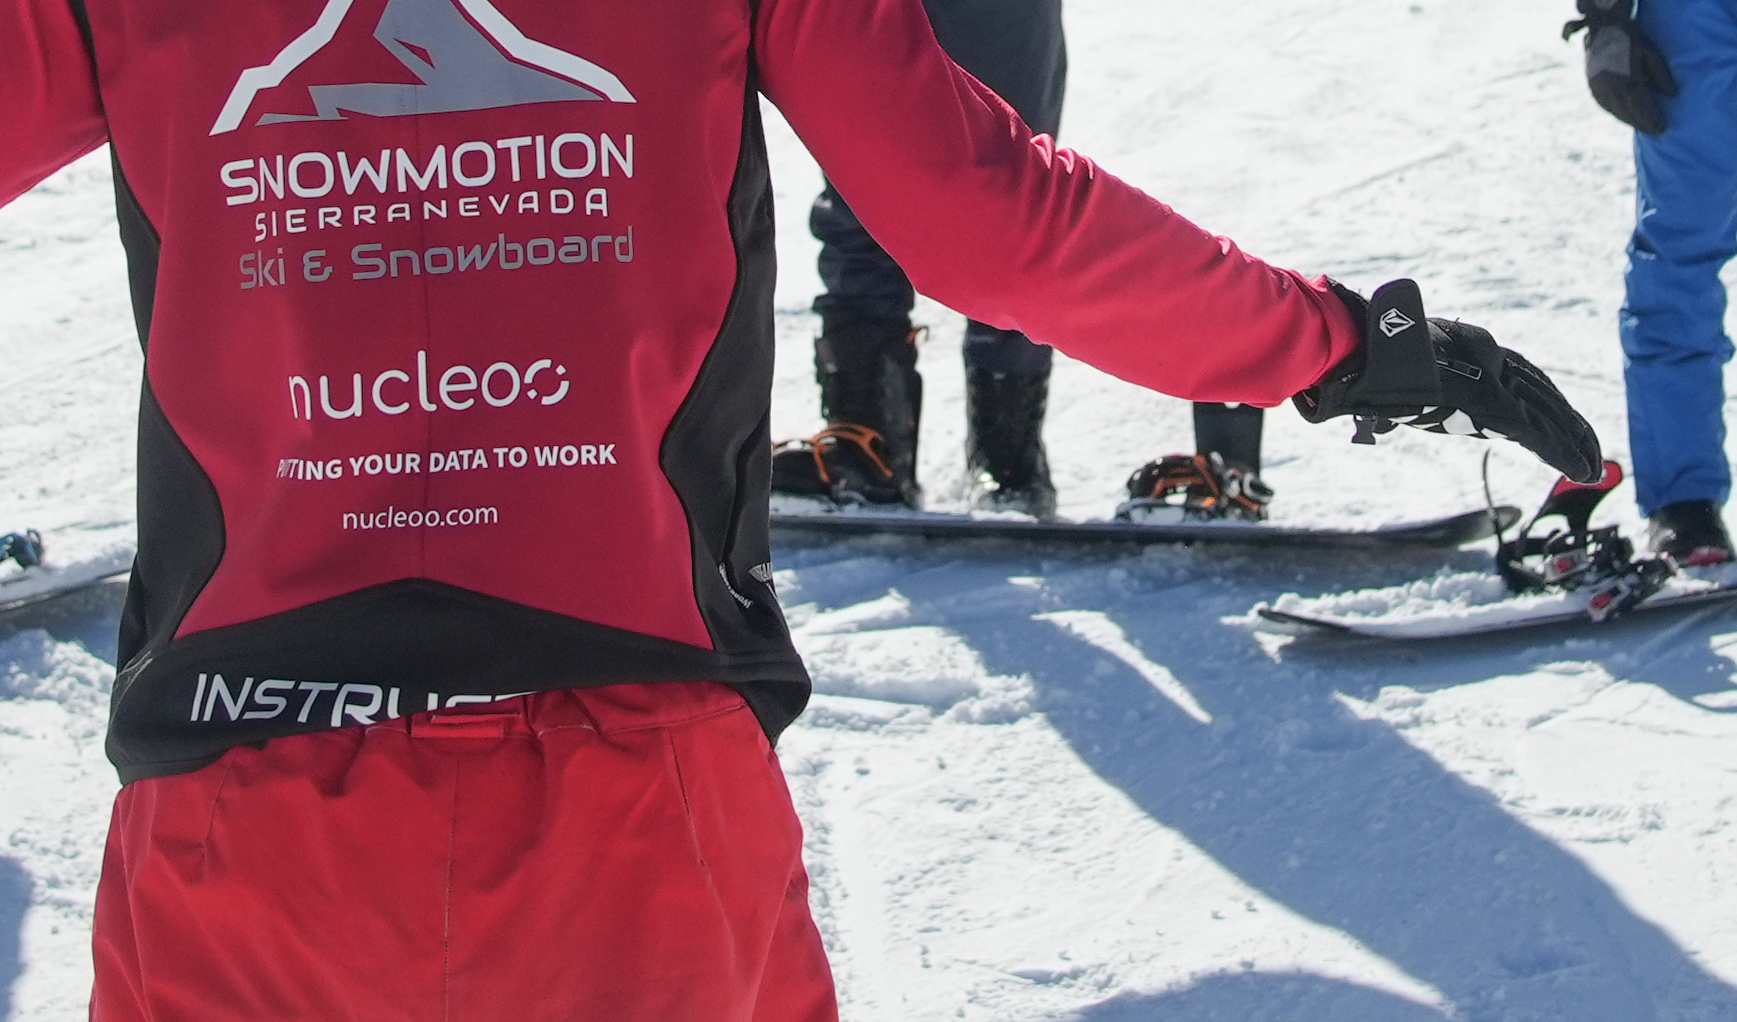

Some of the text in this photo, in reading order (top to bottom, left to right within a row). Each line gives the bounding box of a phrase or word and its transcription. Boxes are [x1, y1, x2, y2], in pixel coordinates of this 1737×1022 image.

[219, 132, 635, 206] SNOWMOTION
[254, 187, 609, 243] SIERRANEVADA
[239, 225, 635, 290] Ski & Snowboard
[287, 349, 570, 421] nucleoo
[276, 443, 618, 481] PTING YOUR DATA TO WORK
[341, 505, 500, 531] nucleoo.com
[189, 672, 538, 728] INSTRU
